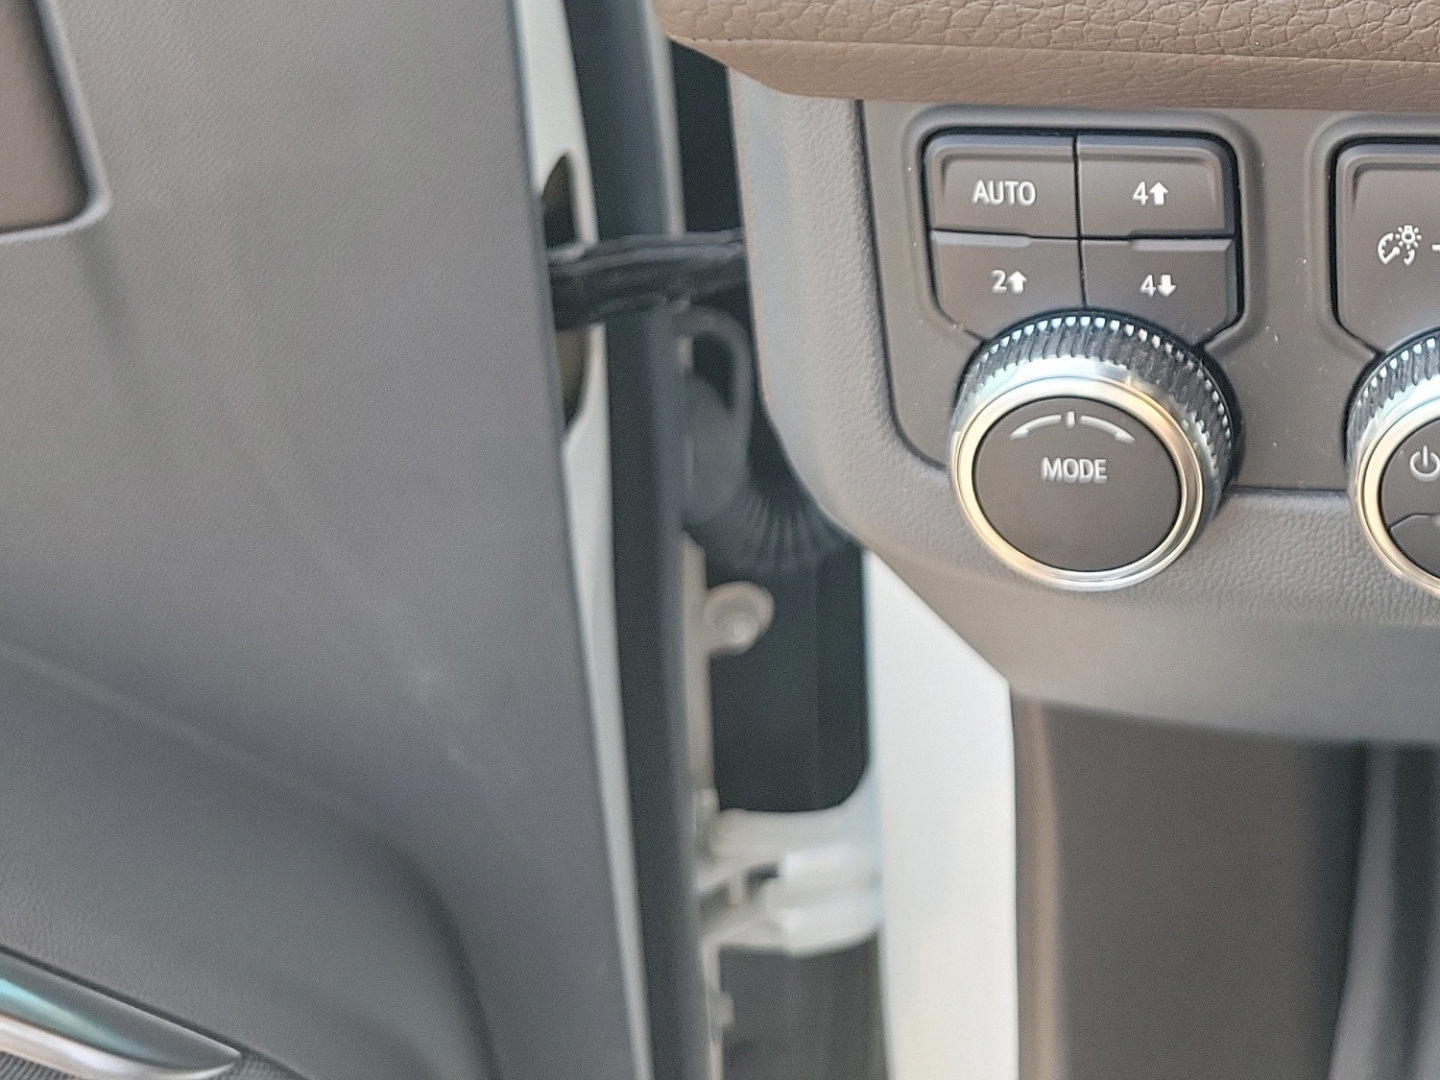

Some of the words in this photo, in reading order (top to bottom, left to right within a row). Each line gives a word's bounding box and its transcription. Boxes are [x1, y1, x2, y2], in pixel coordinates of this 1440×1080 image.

[972, 180, 1037, 206] AUTO
[1132, 181, 1149, 206] 4
[991, 270, 1008, 293] 2
[1140, 273, 1158, 298] 4
[1041, 456, 1108, 484] MODE
